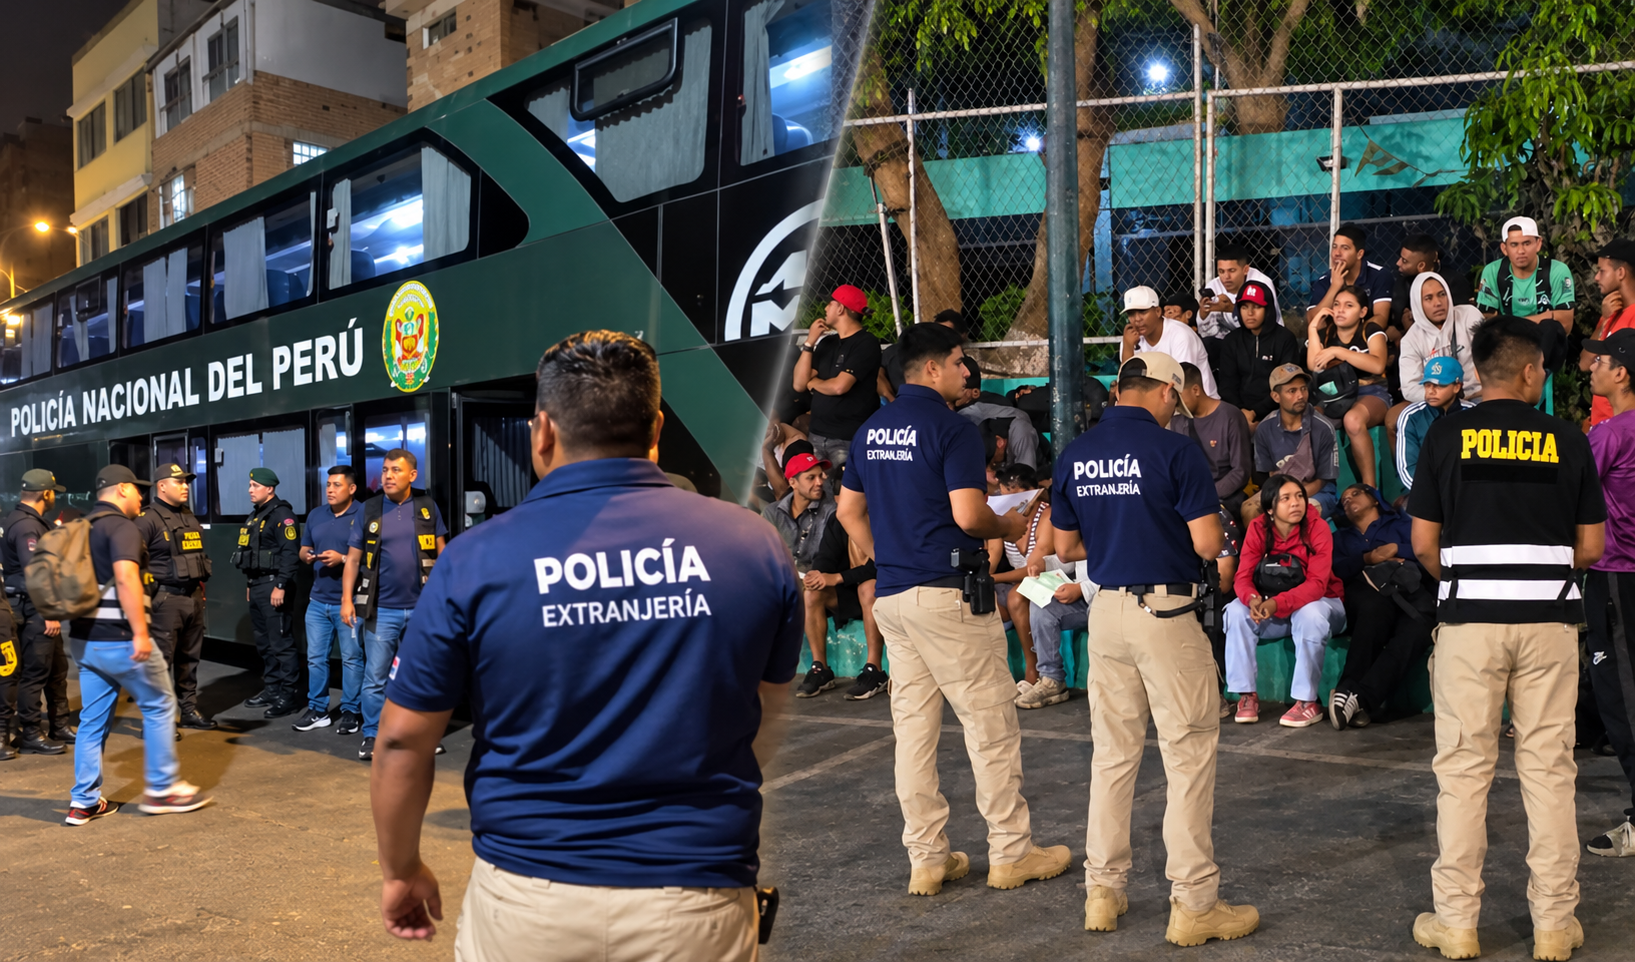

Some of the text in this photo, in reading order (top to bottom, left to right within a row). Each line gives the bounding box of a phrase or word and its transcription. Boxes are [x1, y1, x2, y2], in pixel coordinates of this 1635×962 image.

[10, 317, 364, 438] POLICÍA NACIONAL DEL PERÚ
[866, 425, 917, 447] POLICÍA
[1460, 428, 1560, 464] POLICIA
[1073, 453, 1142, 480] POLICÍA
[1076, 480, 1141, 497] EXTRANJERÍA
[533, 537, 712, 596] POLICÍA
[541, 589, 712, 628] EXTRANJERÍA
